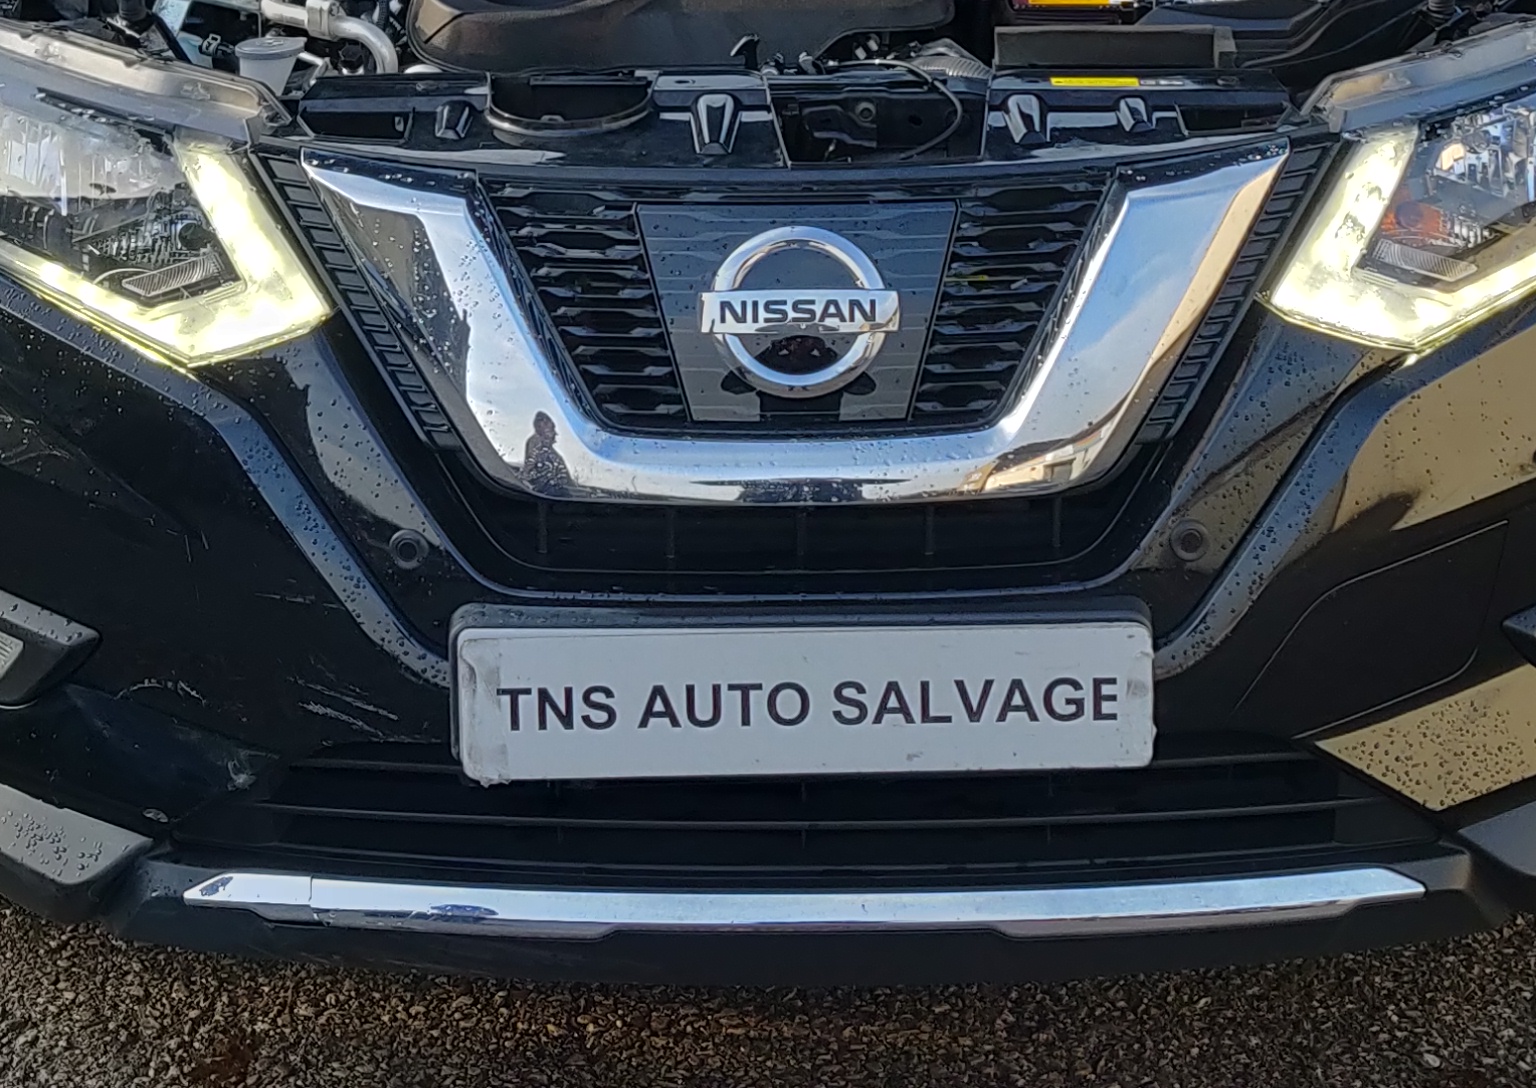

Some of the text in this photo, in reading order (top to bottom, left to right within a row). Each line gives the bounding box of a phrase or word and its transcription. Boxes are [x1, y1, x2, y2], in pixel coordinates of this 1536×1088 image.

[719, 299, 876, 324] NISSAN
[497, 677, 1118, 731] TNS AUTO SALVAGE
